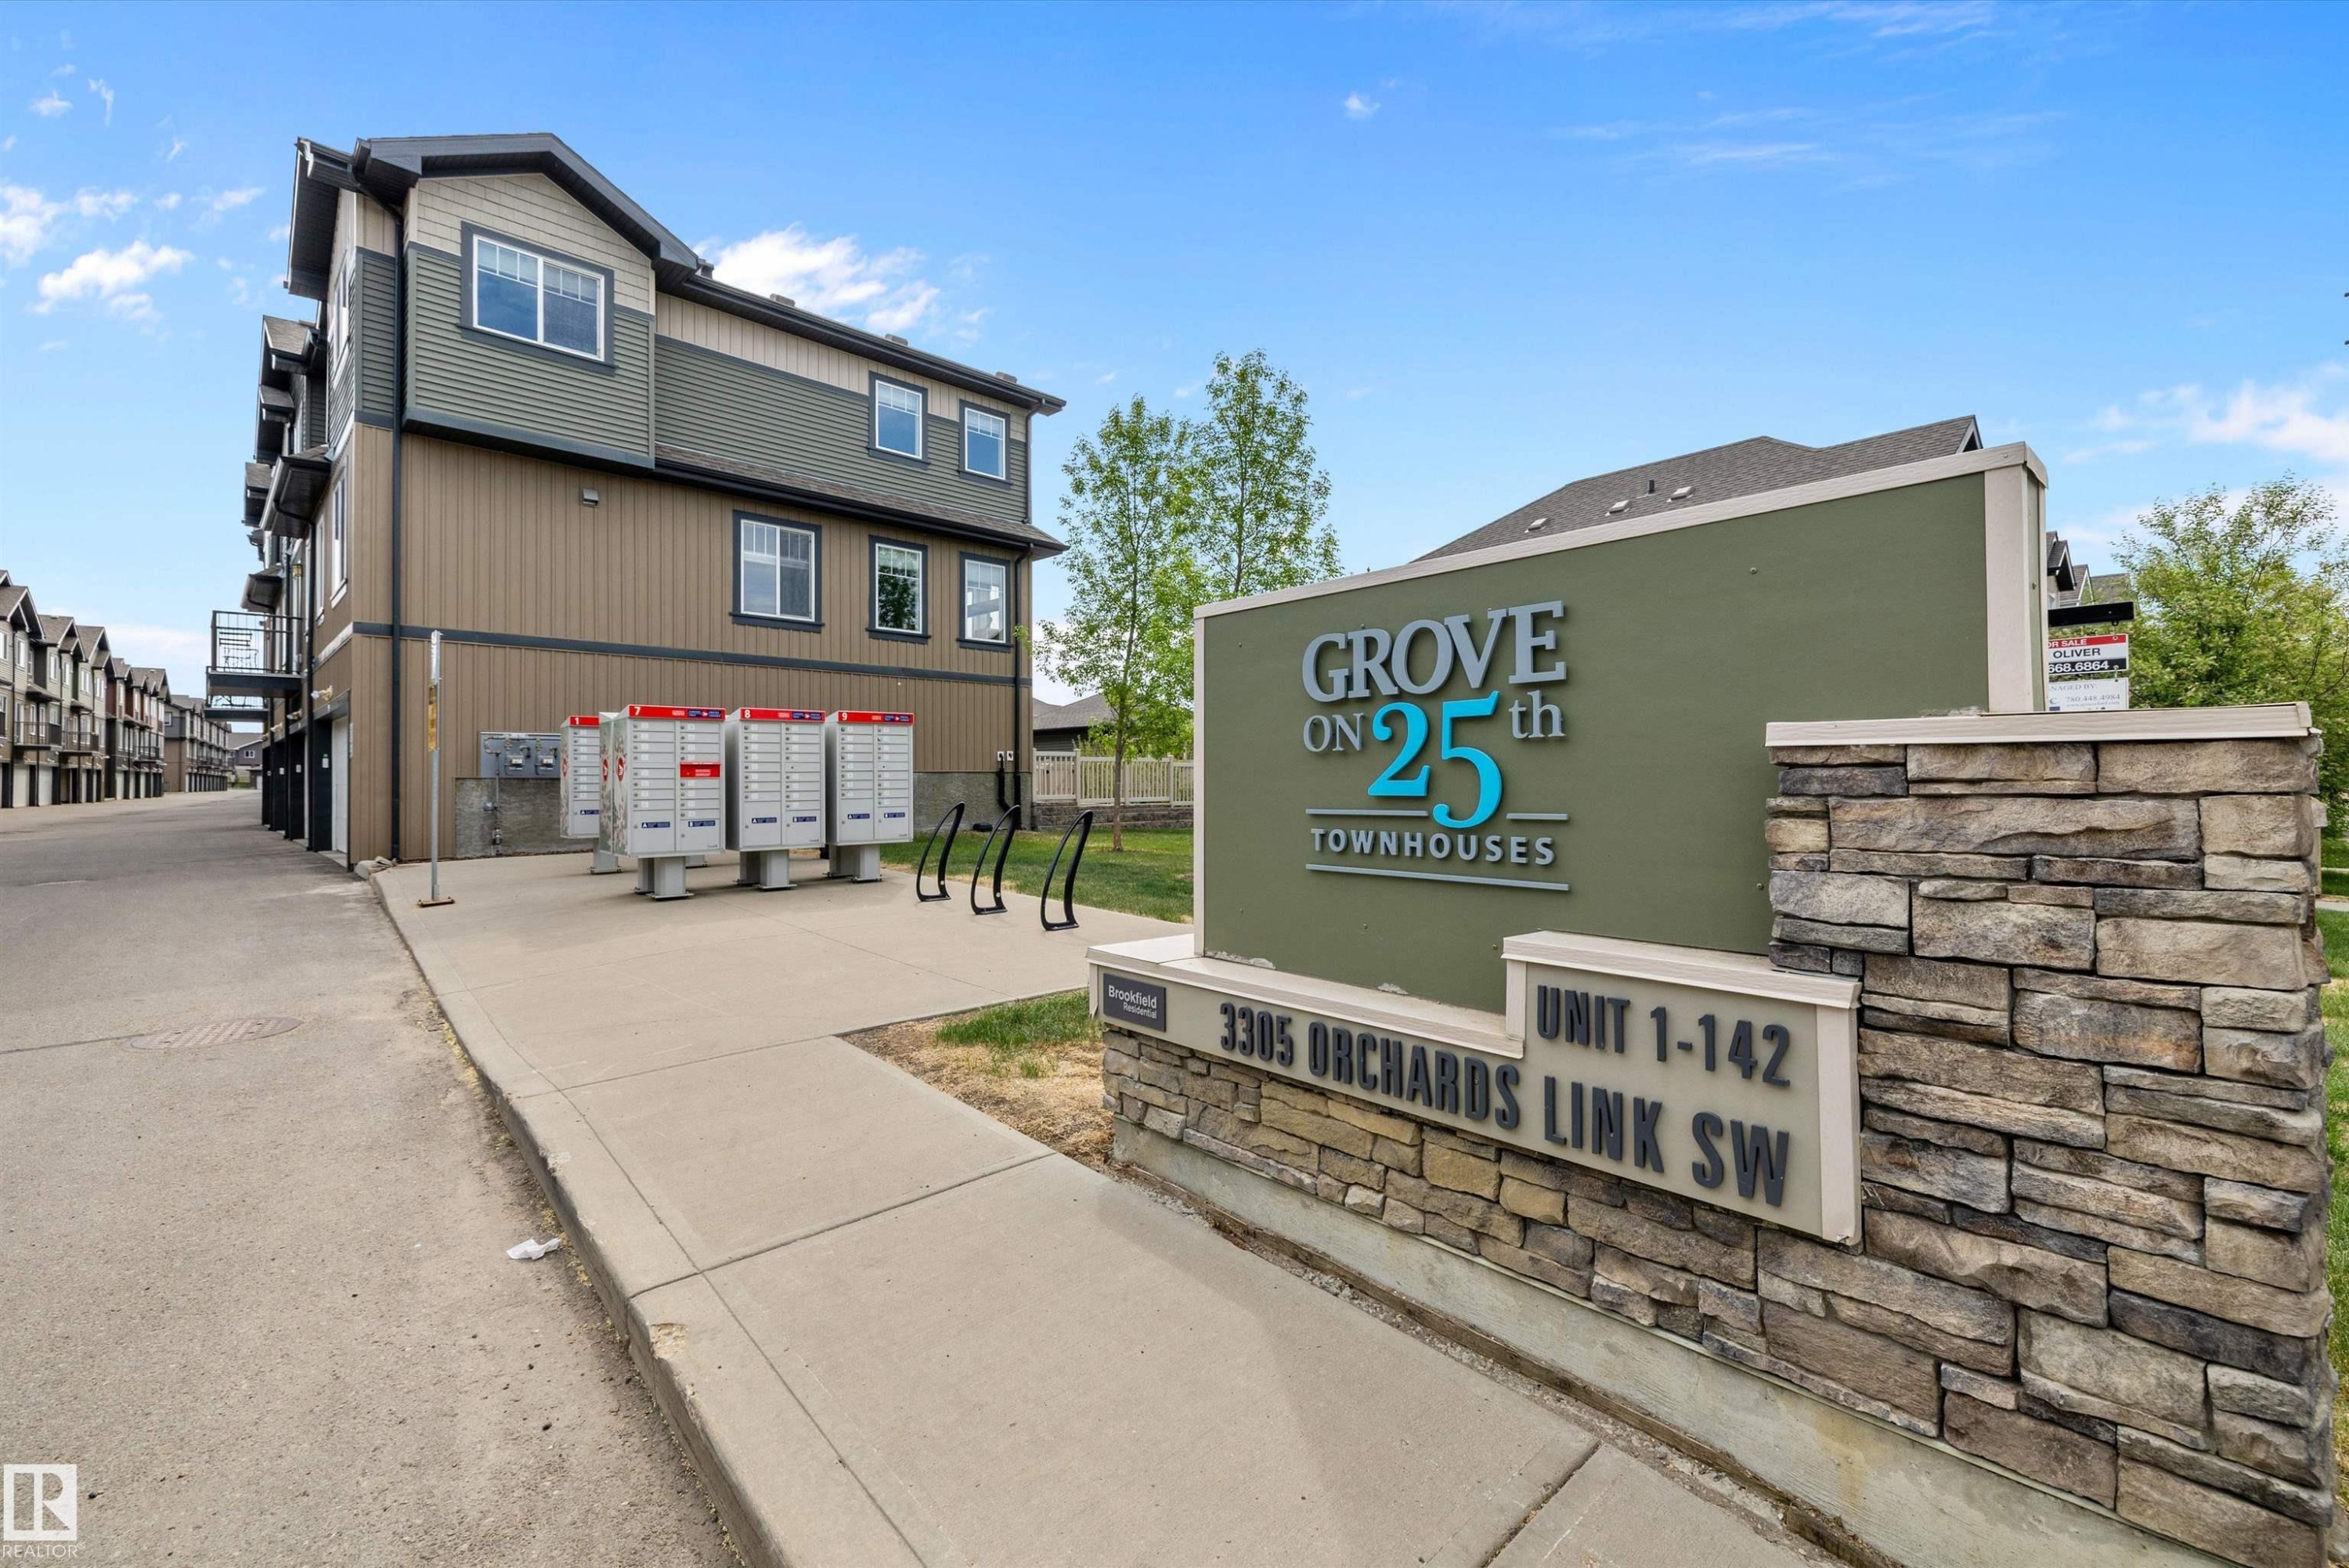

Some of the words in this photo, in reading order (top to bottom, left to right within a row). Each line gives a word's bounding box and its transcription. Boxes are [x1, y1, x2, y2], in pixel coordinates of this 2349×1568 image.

[1301, 600, 1567, 702] GROVE
[2053, 647, 2101, 658] OLIVER
[2061, 638, 2087, 647] SALE
[2048, 660, 2109, 673] 668.6864
[633, 706, 641, 716] 7
[744, 709, 751, 719] 8
[1302, 712, 1364, 752] ON
[1310, 827, 1555, 866] TOWNHOUSES
[1108, 984, 1157, 1009] Brookfield
[1123, 1002, 1157, 1019] Residential
[1537, 985, 1631, 1054] UNIT
[1650, 1006, 1792, 1087] 1-142
[1219, 1002, 1294, 1068] 3305
[1308, 1021, 1520, 1130] ORCHARDS
[1544, 1076, 1665, 1173] LINK
[1691, 1112, 1790, 1207] SW
